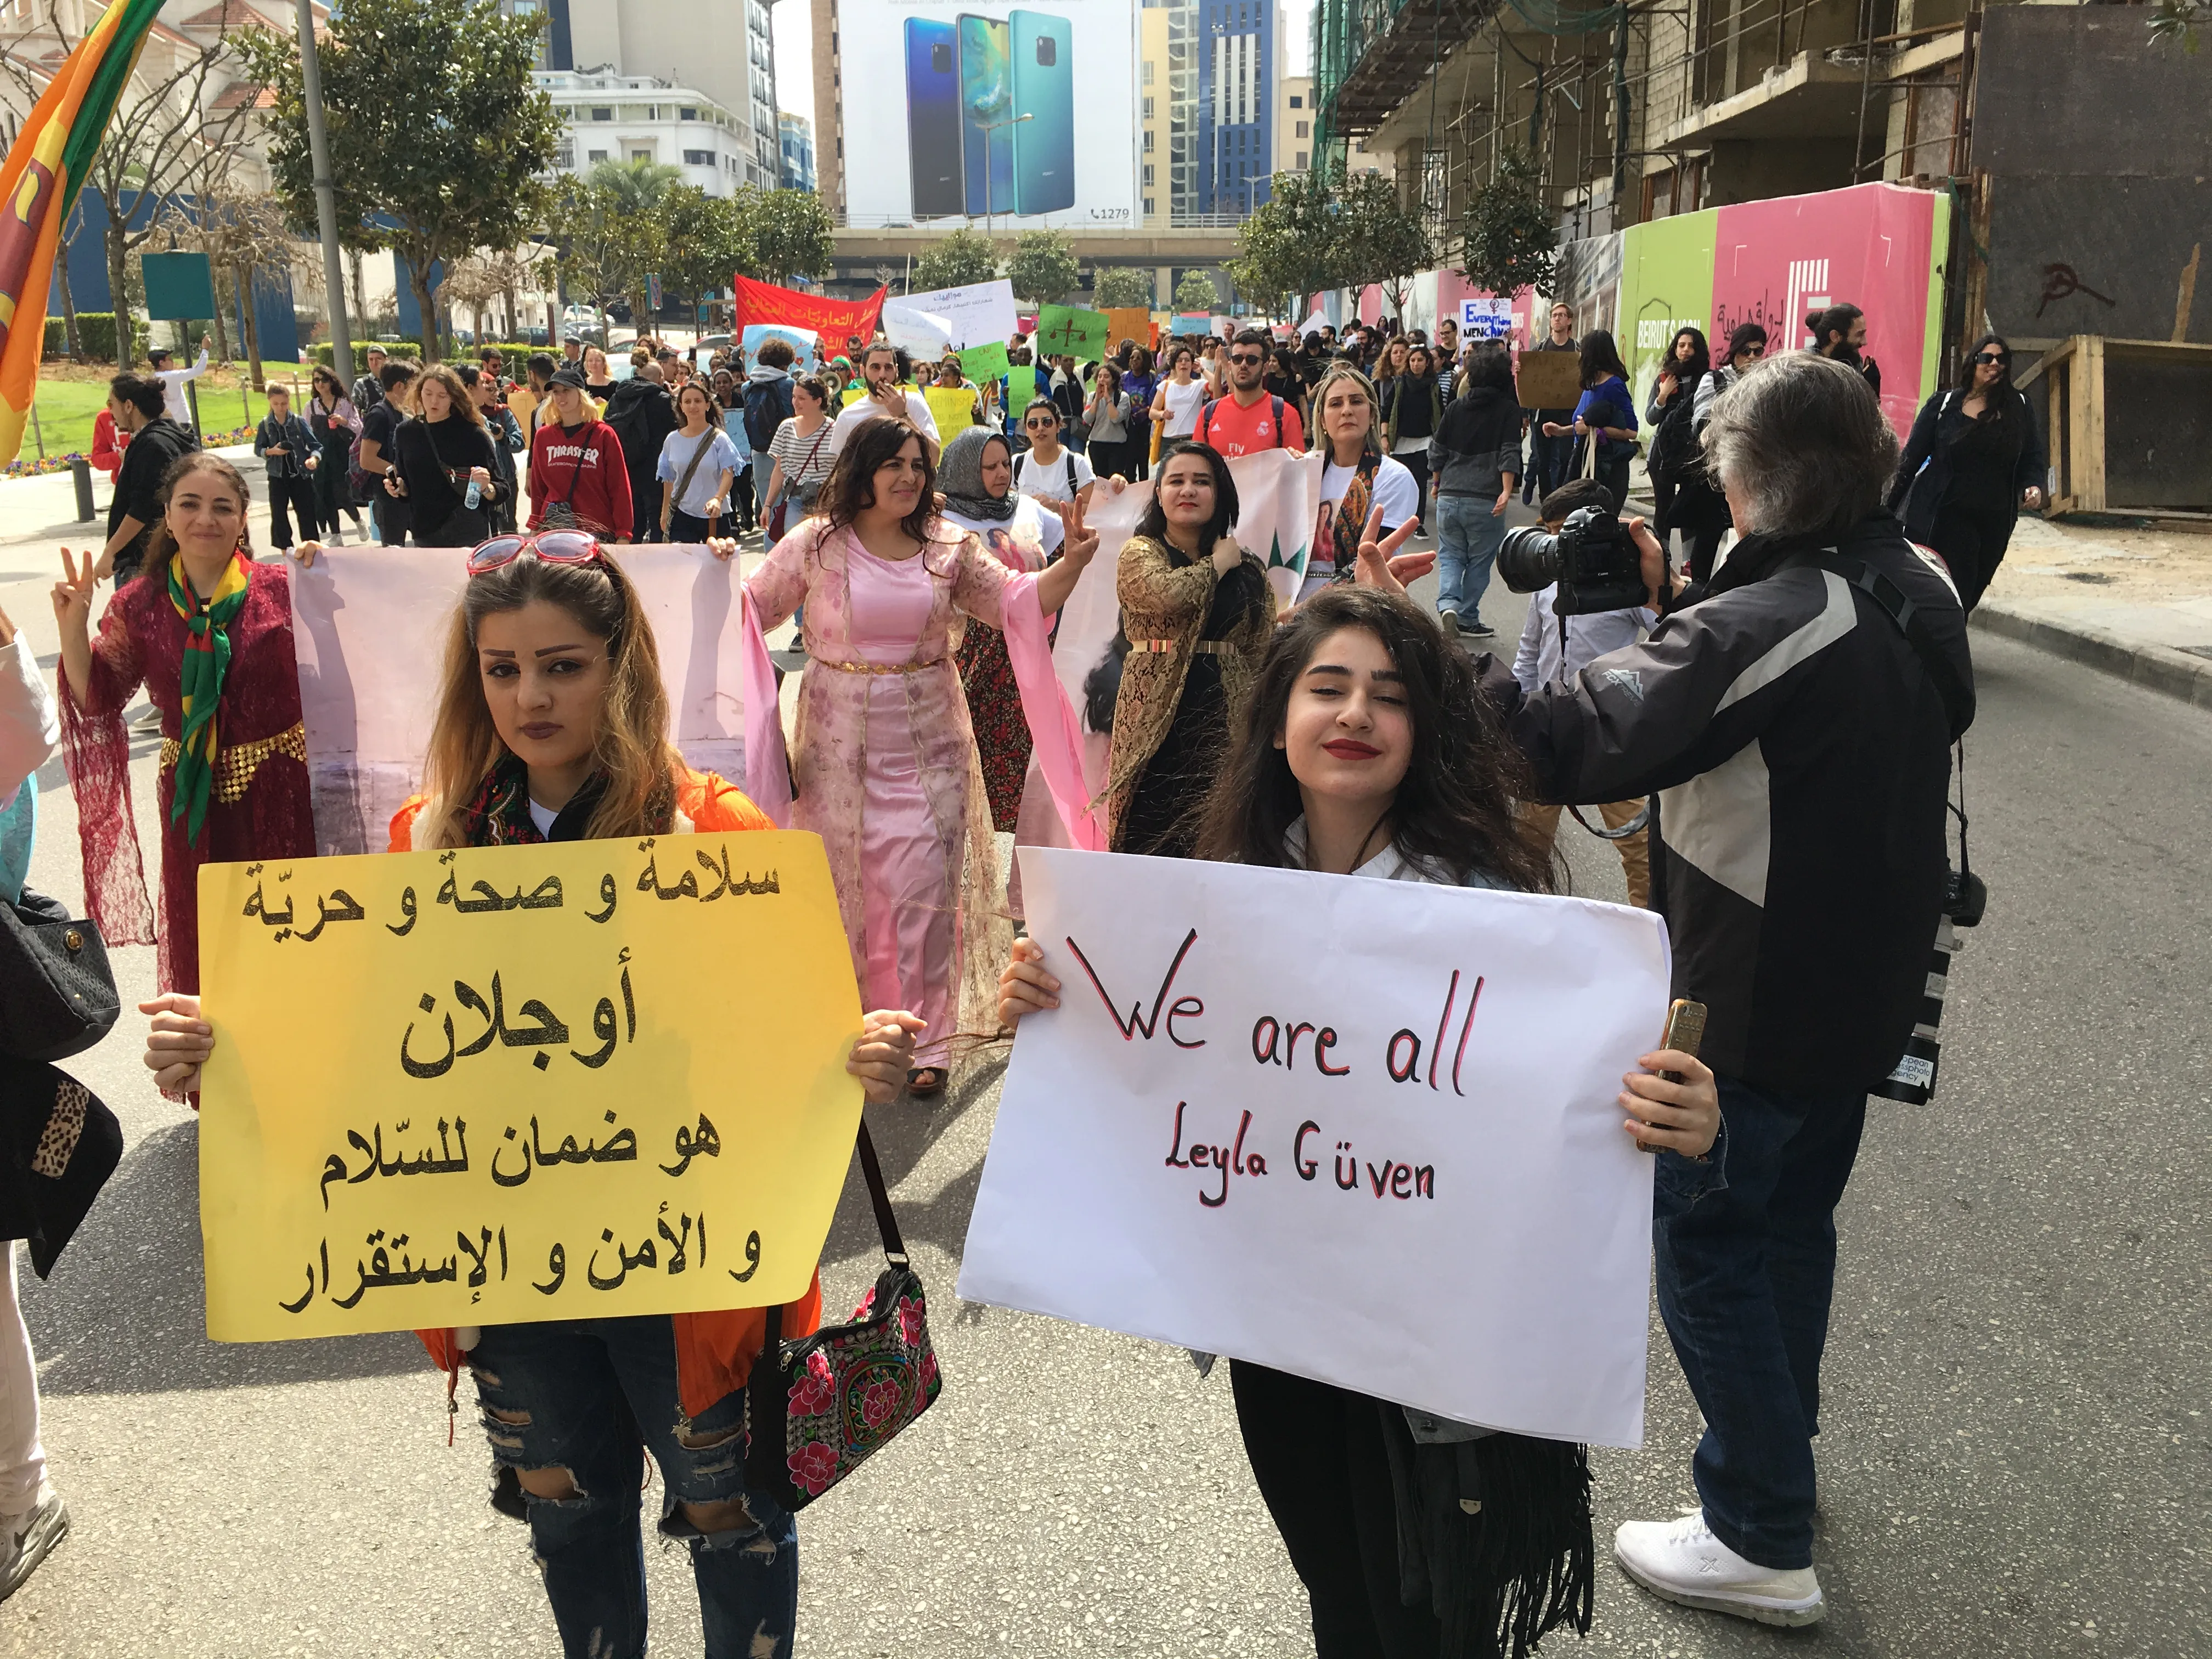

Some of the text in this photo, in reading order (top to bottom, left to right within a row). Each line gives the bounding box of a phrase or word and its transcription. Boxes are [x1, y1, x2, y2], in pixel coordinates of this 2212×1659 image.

[1101, 208, 1130, 219] 1279
[1463, 328, 1484, 338] MEN
[1637, 319, 1676, 349] BEIRUT'S
[931, 395, 970, 408] FEMINISM
[1228, 443, 1245, 454] Fly
[437, 850, 563, 913] صحة
[636, 838, 780, 902] سلامة
[386, 887, 417, 936] و
[584, 874, 617, 924] و
[401, 947, 636, 1079] أوجلان
[1066, 928, 1485, 1097] We are all
[1902, 1057, 1929, 1068] opean
[492, 1109, 637, 1187] ضمان
[658, 1113, 721, 1177] هو
[1165, 1102, 1435, 1209] Leyla Güven
[279, 1201, 761, 1314] و الأمن و الإستقرار
